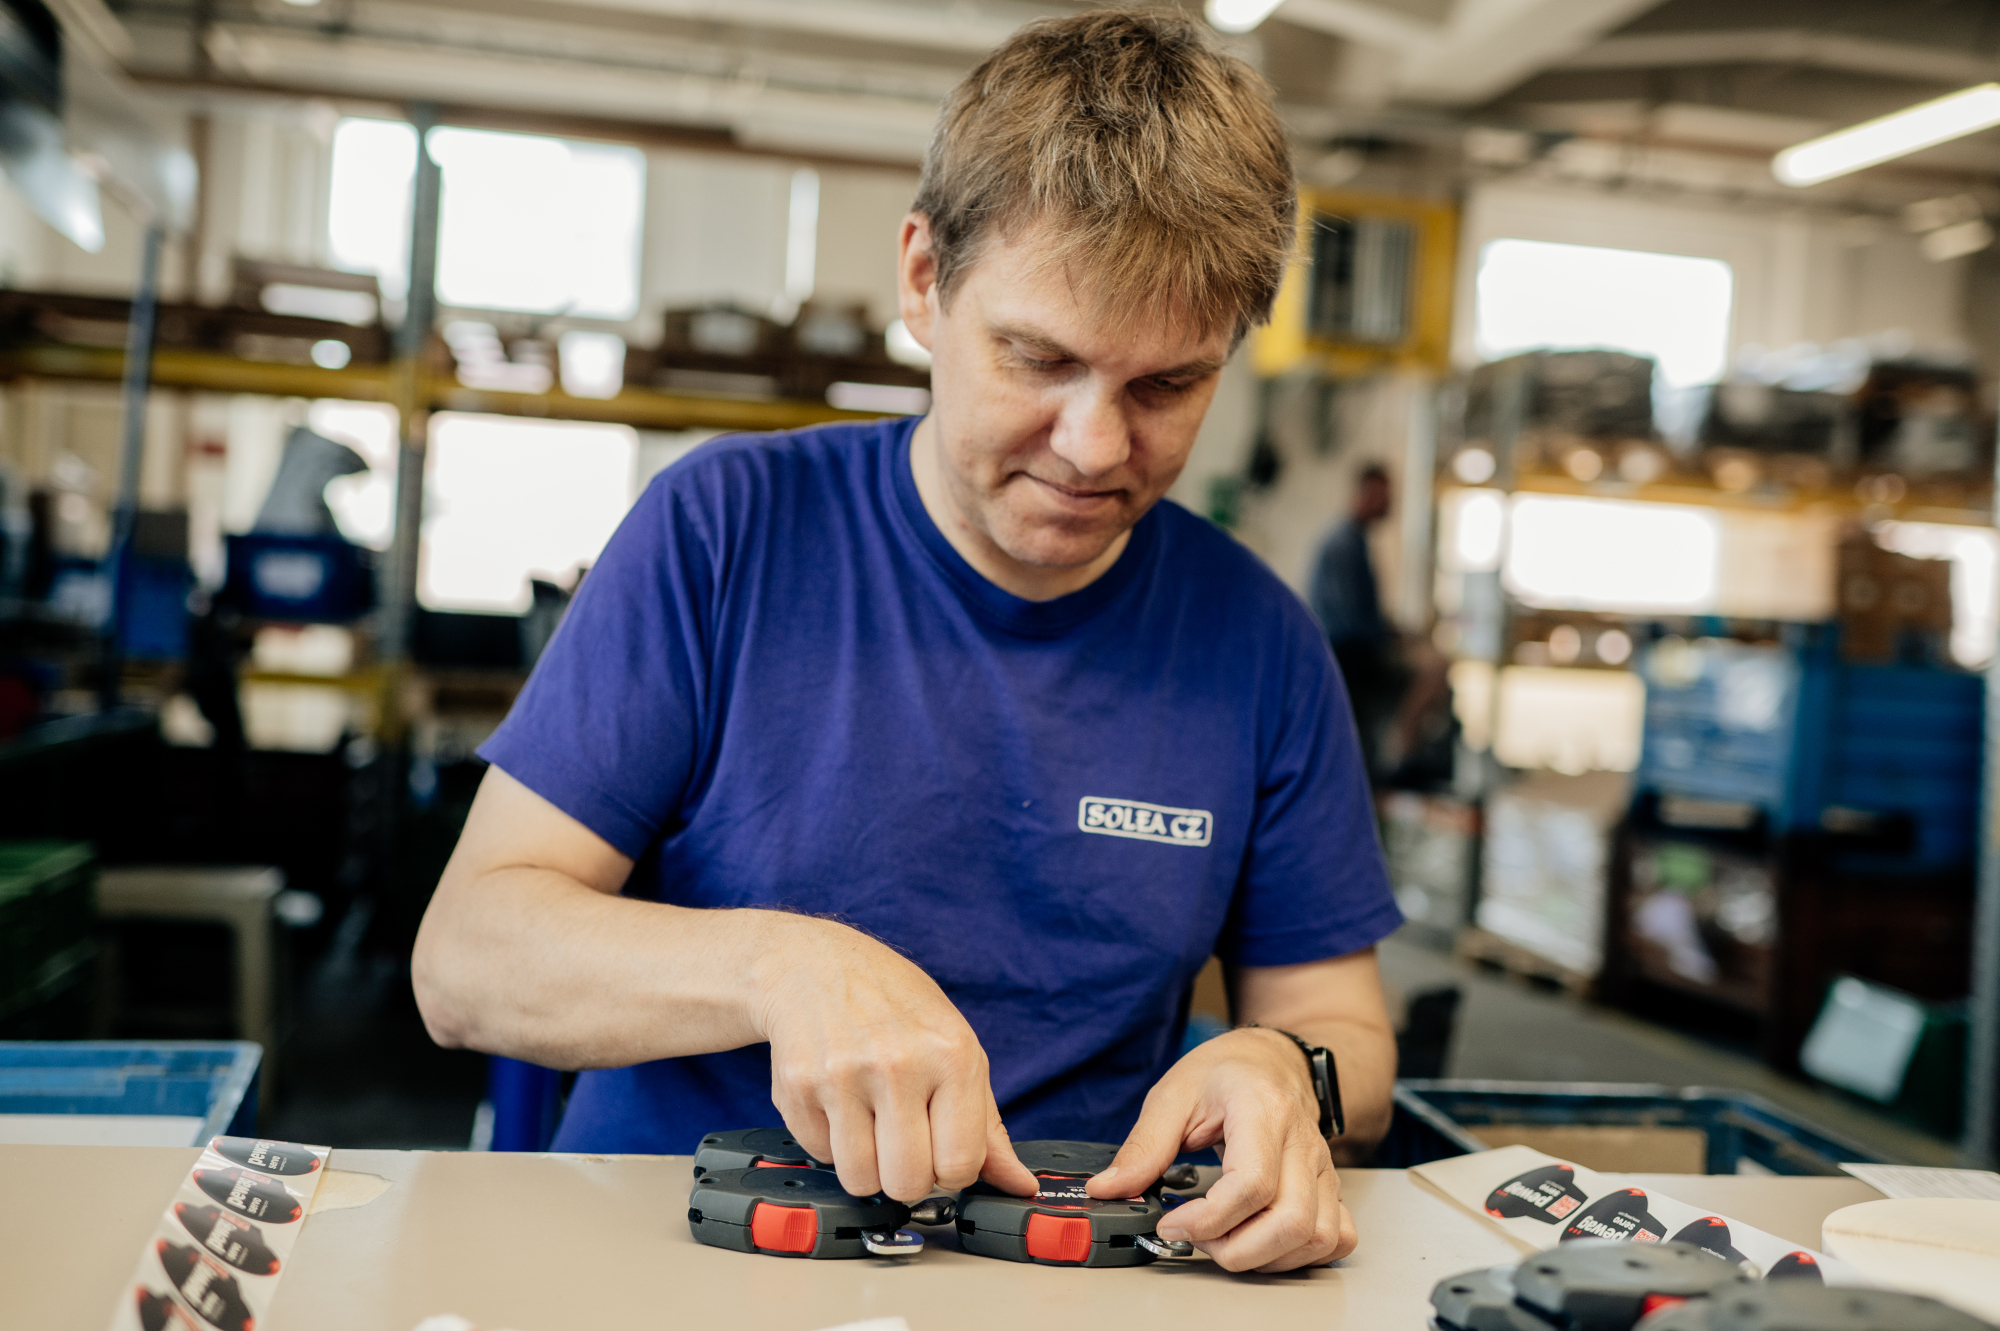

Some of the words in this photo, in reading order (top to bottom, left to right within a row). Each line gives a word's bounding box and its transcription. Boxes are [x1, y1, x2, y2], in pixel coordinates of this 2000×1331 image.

[1086, 803, 1167, 835] SOLEA
[1170, 815, 1204, 839] CZ
[226, 1176, 258, 1210] pewag
[1503, 1181, 1554, 1208] pewag
[1576, 1215, 1629, 1242] pewag
[1612, 1216, 1636, 1231] servo
